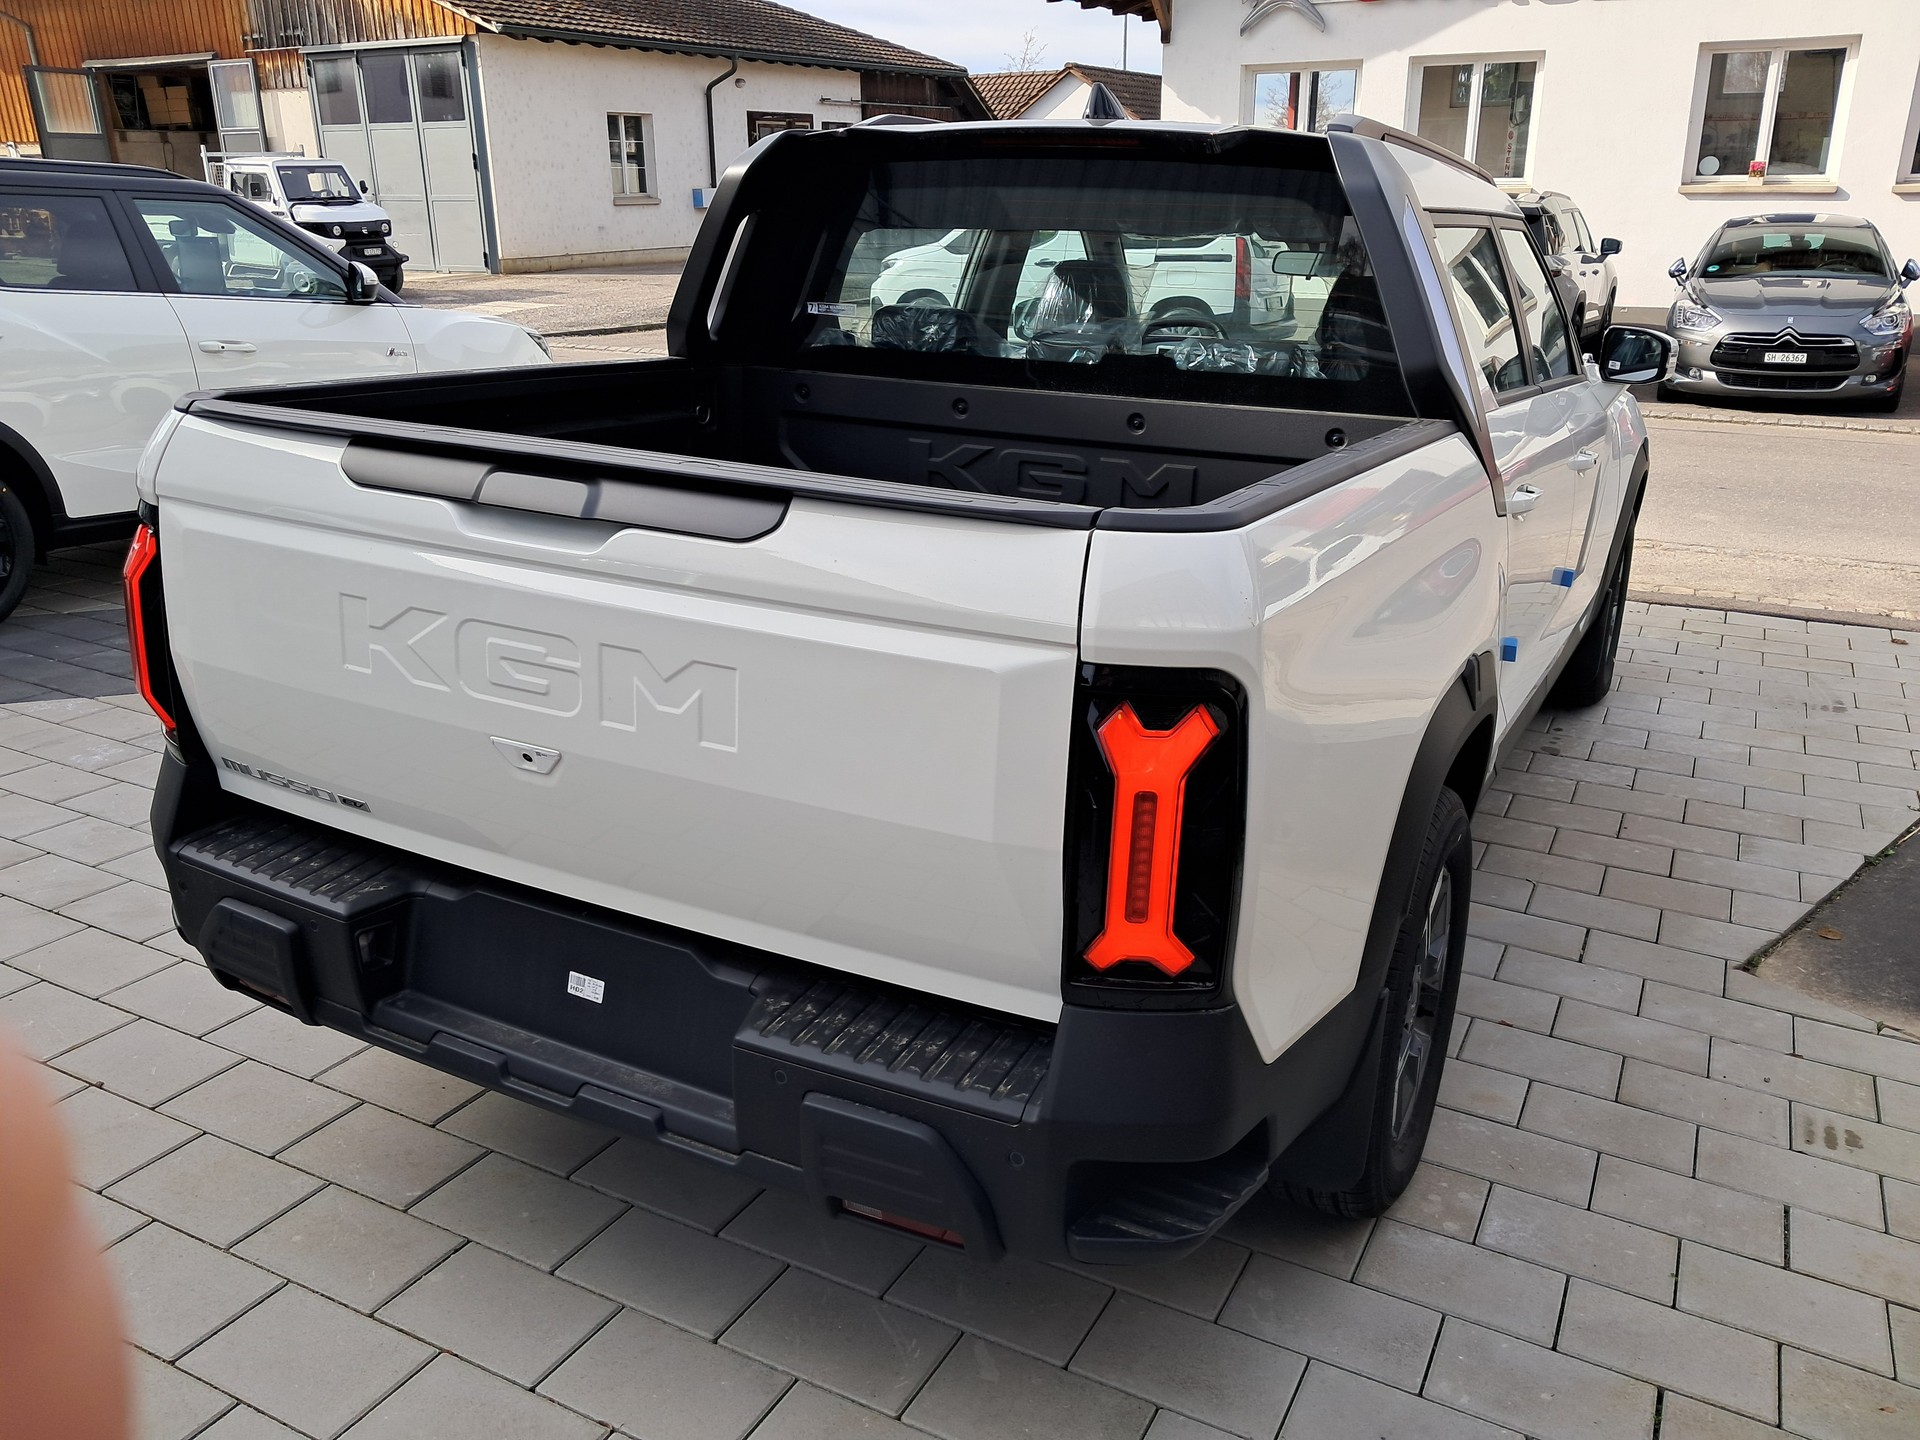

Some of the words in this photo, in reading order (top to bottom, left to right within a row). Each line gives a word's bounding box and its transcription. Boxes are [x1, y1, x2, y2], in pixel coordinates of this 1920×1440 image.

[1766, 353, 1776, 361] SH
[1780, 353, 1805, 362] 26362
[908, 438, 1197, 506] KGM
[339, 592, 739, 752] KGM
[221, 757, 338, 803] MUSSO
